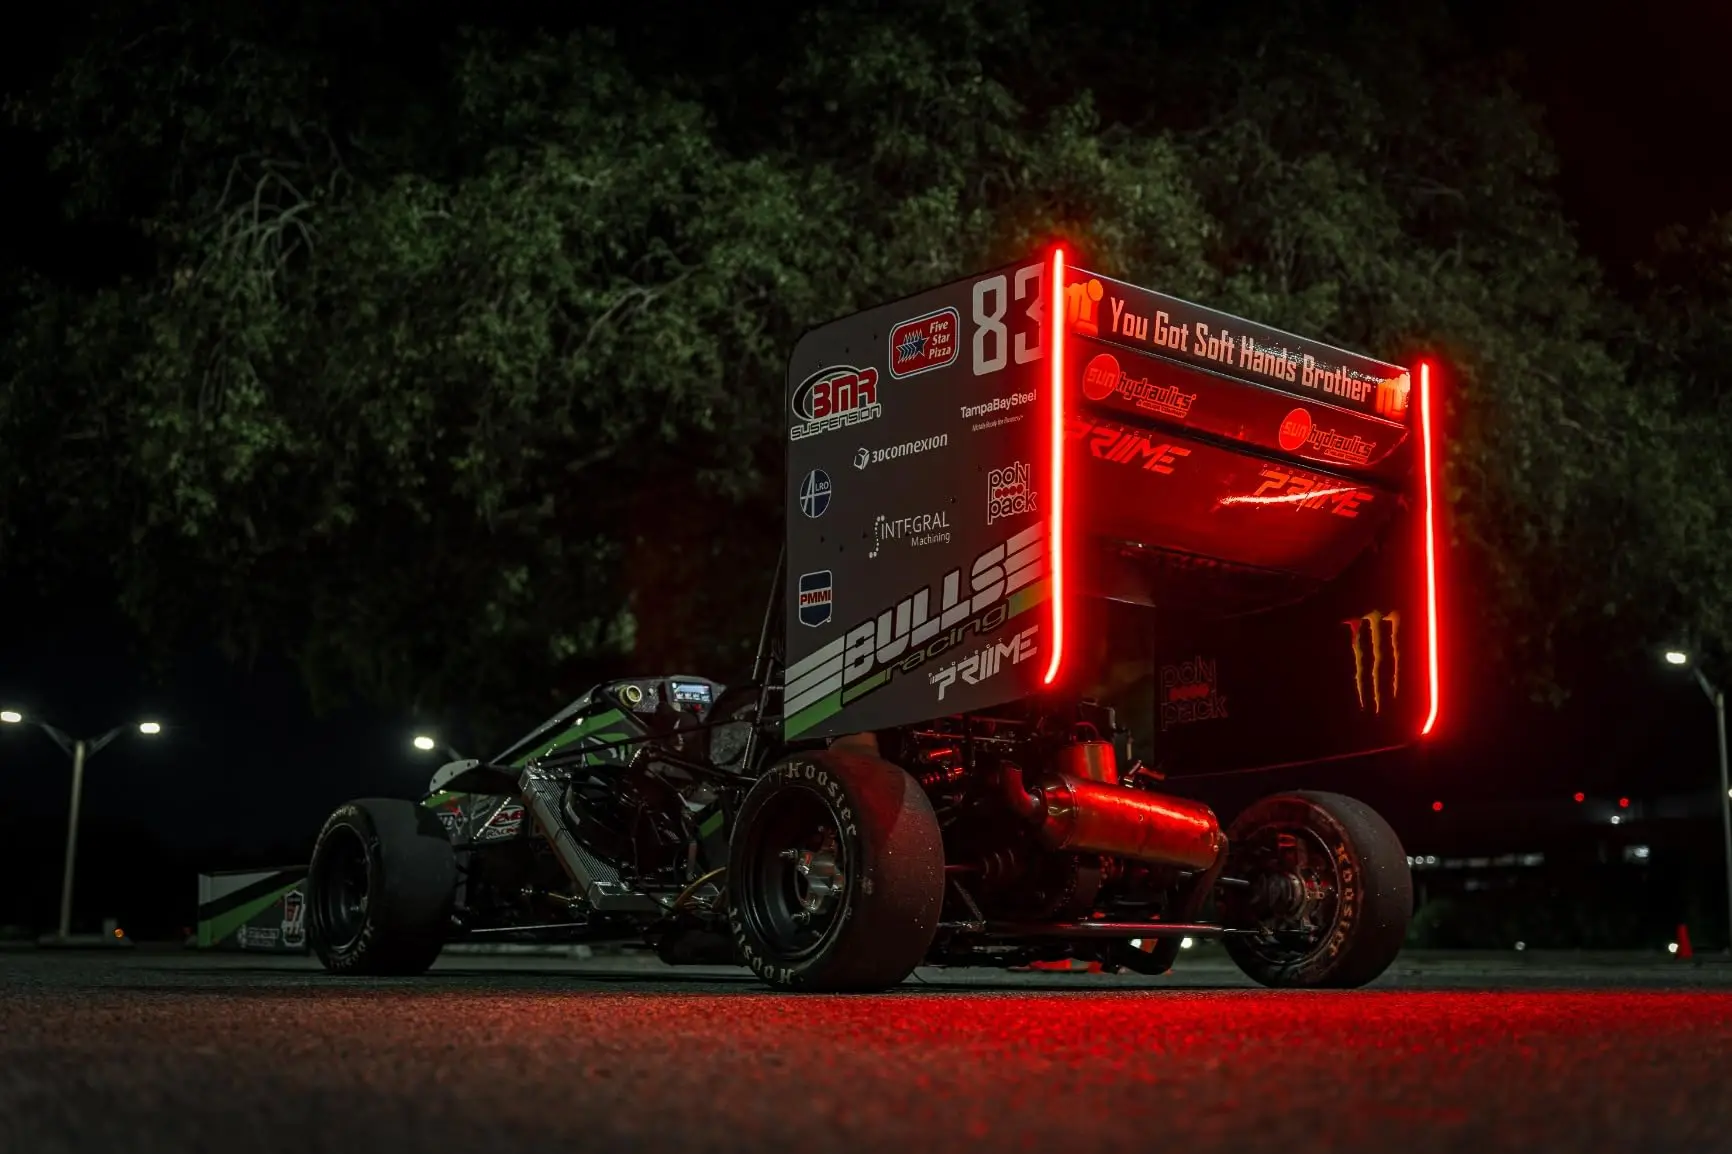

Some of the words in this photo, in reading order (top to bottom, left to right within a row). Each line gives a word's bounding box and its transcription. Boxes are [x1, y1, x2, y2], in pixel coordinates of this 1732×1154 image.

[929, 320, 949, 333] Five
[972, 262, 1046, 376] 83
[928, 345, 951, 360] Pizza
[932, 333, 951, 345] Star
[1111, 297, 1149, 341] You
[1154, 311, 1189, 352] Got
[1194, 322, 1235, 365] Soft
[1240, 335, 1297, 383] Hands
[1302, 353, 1372, 403] Brother
[812, 366, 879, 420] BMR
[960, 389, 1038, 419] TampaBaySteel
[1087, 367, 1116, 388] sun
[1116, 371, 1192, 411] hydraulics
[790, 403, 882, 441] SUSPENSION
[1281, 420, 1308, 438] sun
[1307, 423, 1374, 456] hydraulics
[987, 489, 1038, 525] pack
[881, 511, 950, 540] INTEGRAL
[911, 532, 951, 547] Machining
[800, 590, 832, 606] PMMI
[844, 543, 1006, 685] BULLS
[886, 603, 1006, 681] racing
[1160, 694, 1229, 732] pack
